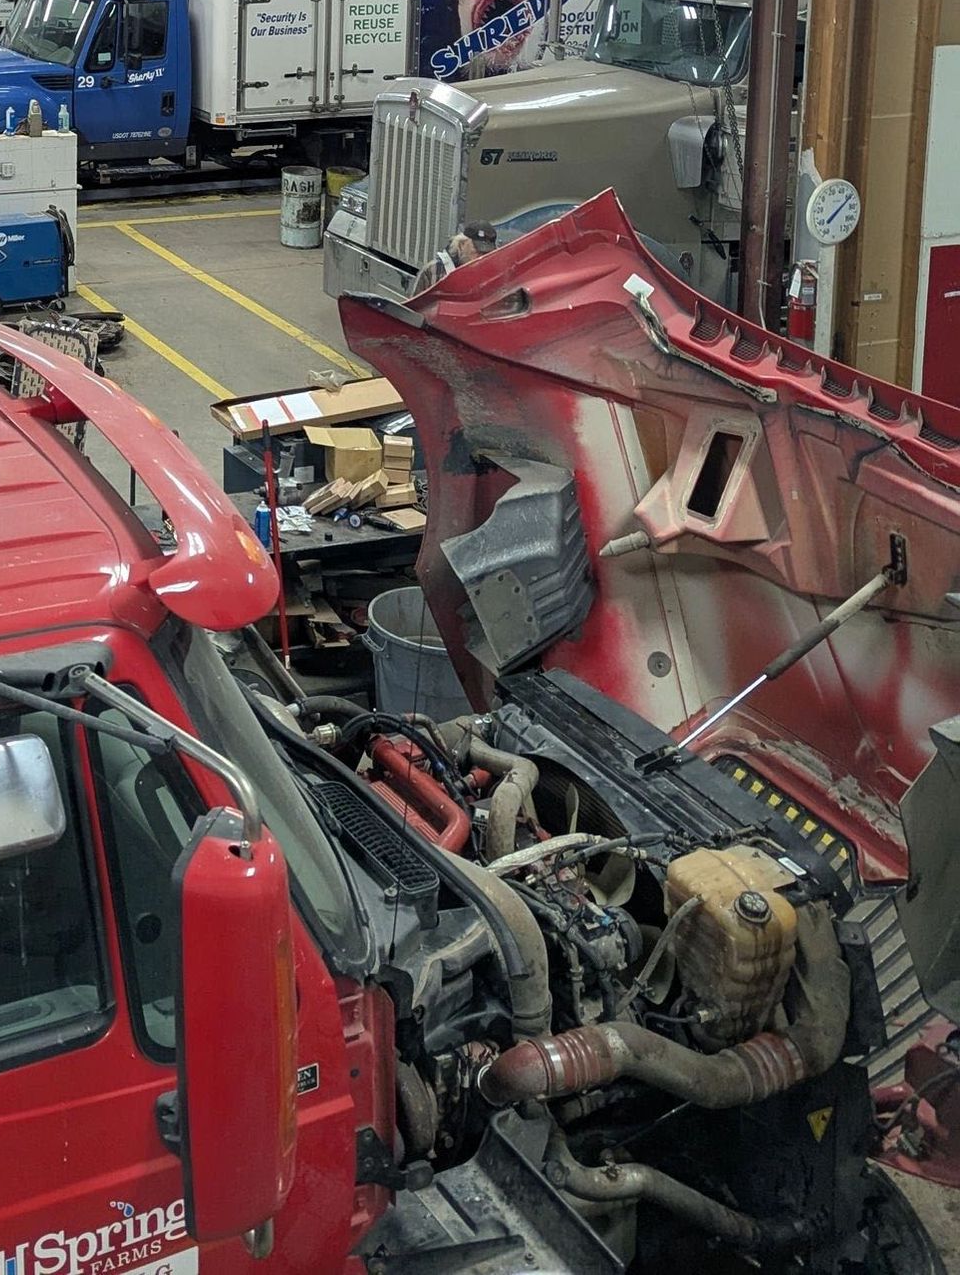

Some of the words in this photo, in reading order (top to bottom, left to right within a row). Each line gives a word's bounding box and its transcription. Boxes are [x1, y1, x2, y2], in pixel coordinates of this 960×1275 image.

[349, 3, 400, 16] REDUCE
[256, 12, 297, 24] "Security
[298, 11, 307, 22] Is
[353, 18, 395, 30] REUSE
[250, 26, 267, 37] Our
[268, 24, 313, 36] Business"
[345, 31, 402, 45] RECYCLE
[77, 76, 95, 88] 29
[283, 178, 315, 193] RASH
[90, 1239, 162, 1275] FARMS
